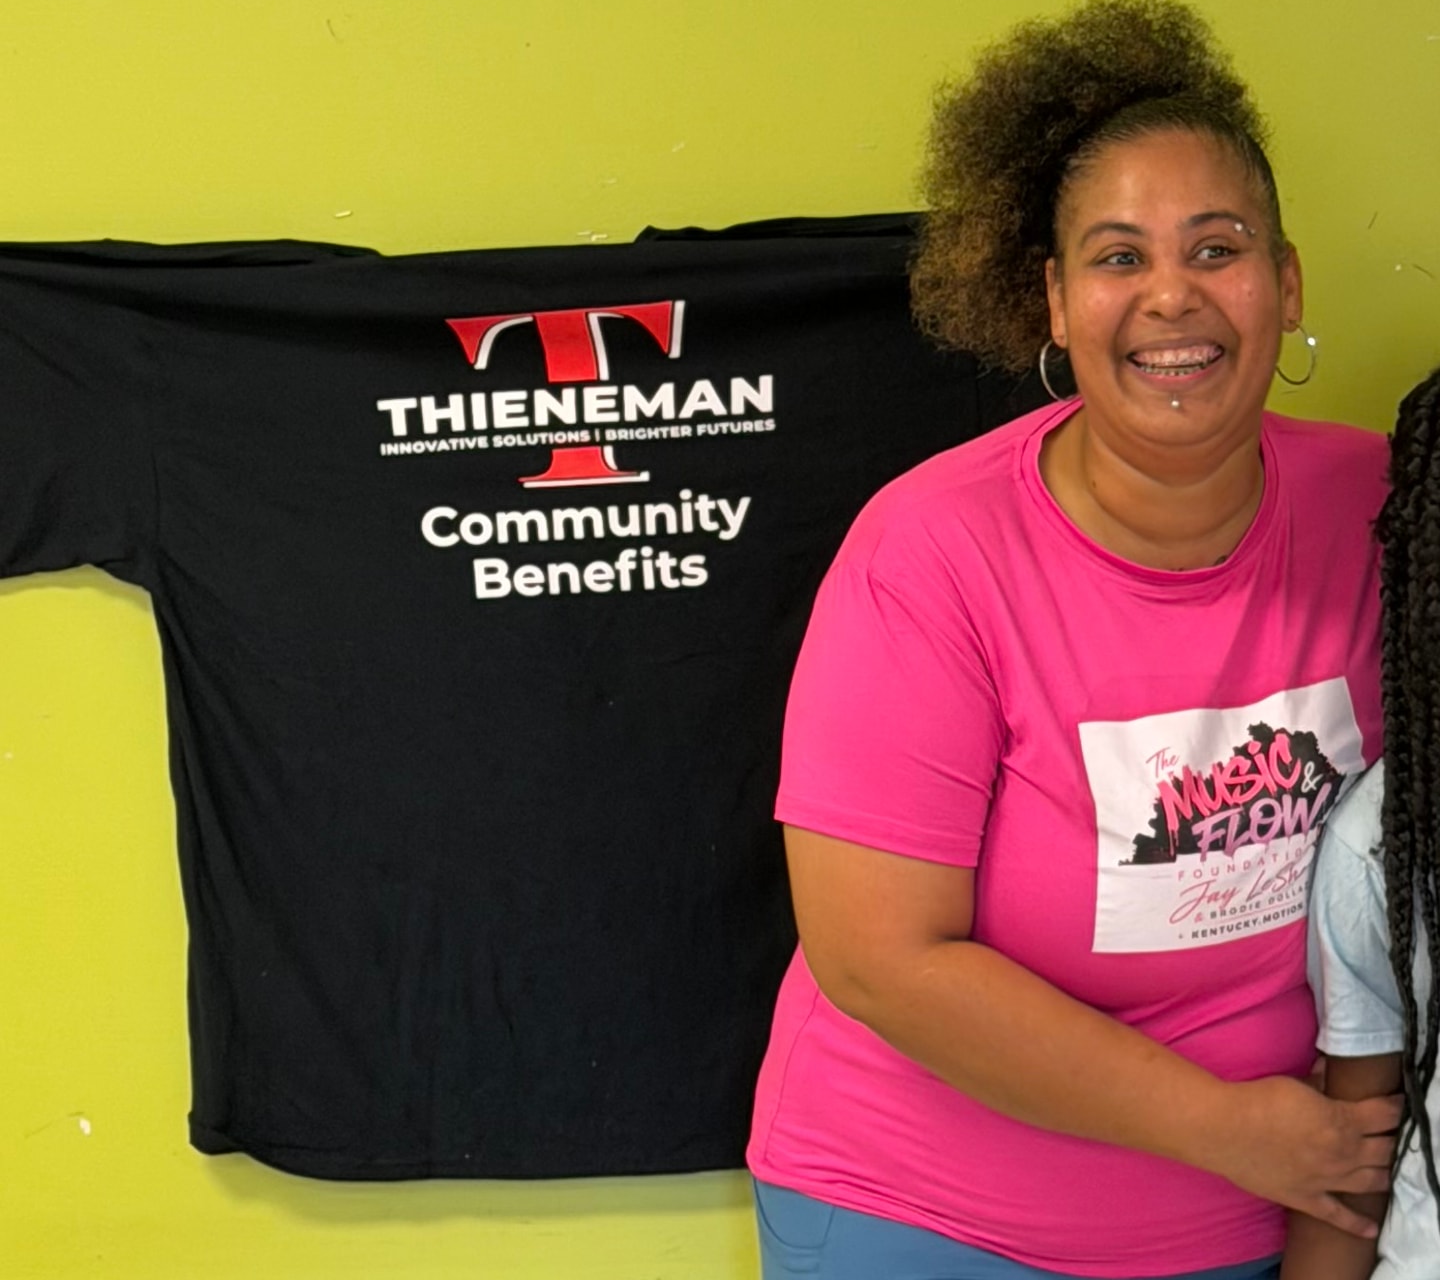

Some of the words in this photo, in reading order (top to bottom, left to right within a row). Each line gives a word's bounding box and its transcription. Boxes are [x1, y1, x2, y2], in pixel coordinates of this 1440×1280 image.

[376, 375, 774, 436] THIENEMAN
[380, 436, 489, 456] INNOVATIVE
[493, 429, 591, 449] SOLUTIONS
[605, 424, 693, 441] BRIGHTER
[697, 418, 776, 436] FUTURES
[421, 489, 751, 547] Community
[473, 546, 708, 599] Benefits
[1145, 746, 1180, 777] The
[1301, 762, 1323, 794] &
[1191, 782, 1332, 862] FLOW
[1177, 847, 1308, 882] FOUNDATIO
[1169, 879, 1240, 925] Jay
[1210, 901, 1262, 920] BRODIE
